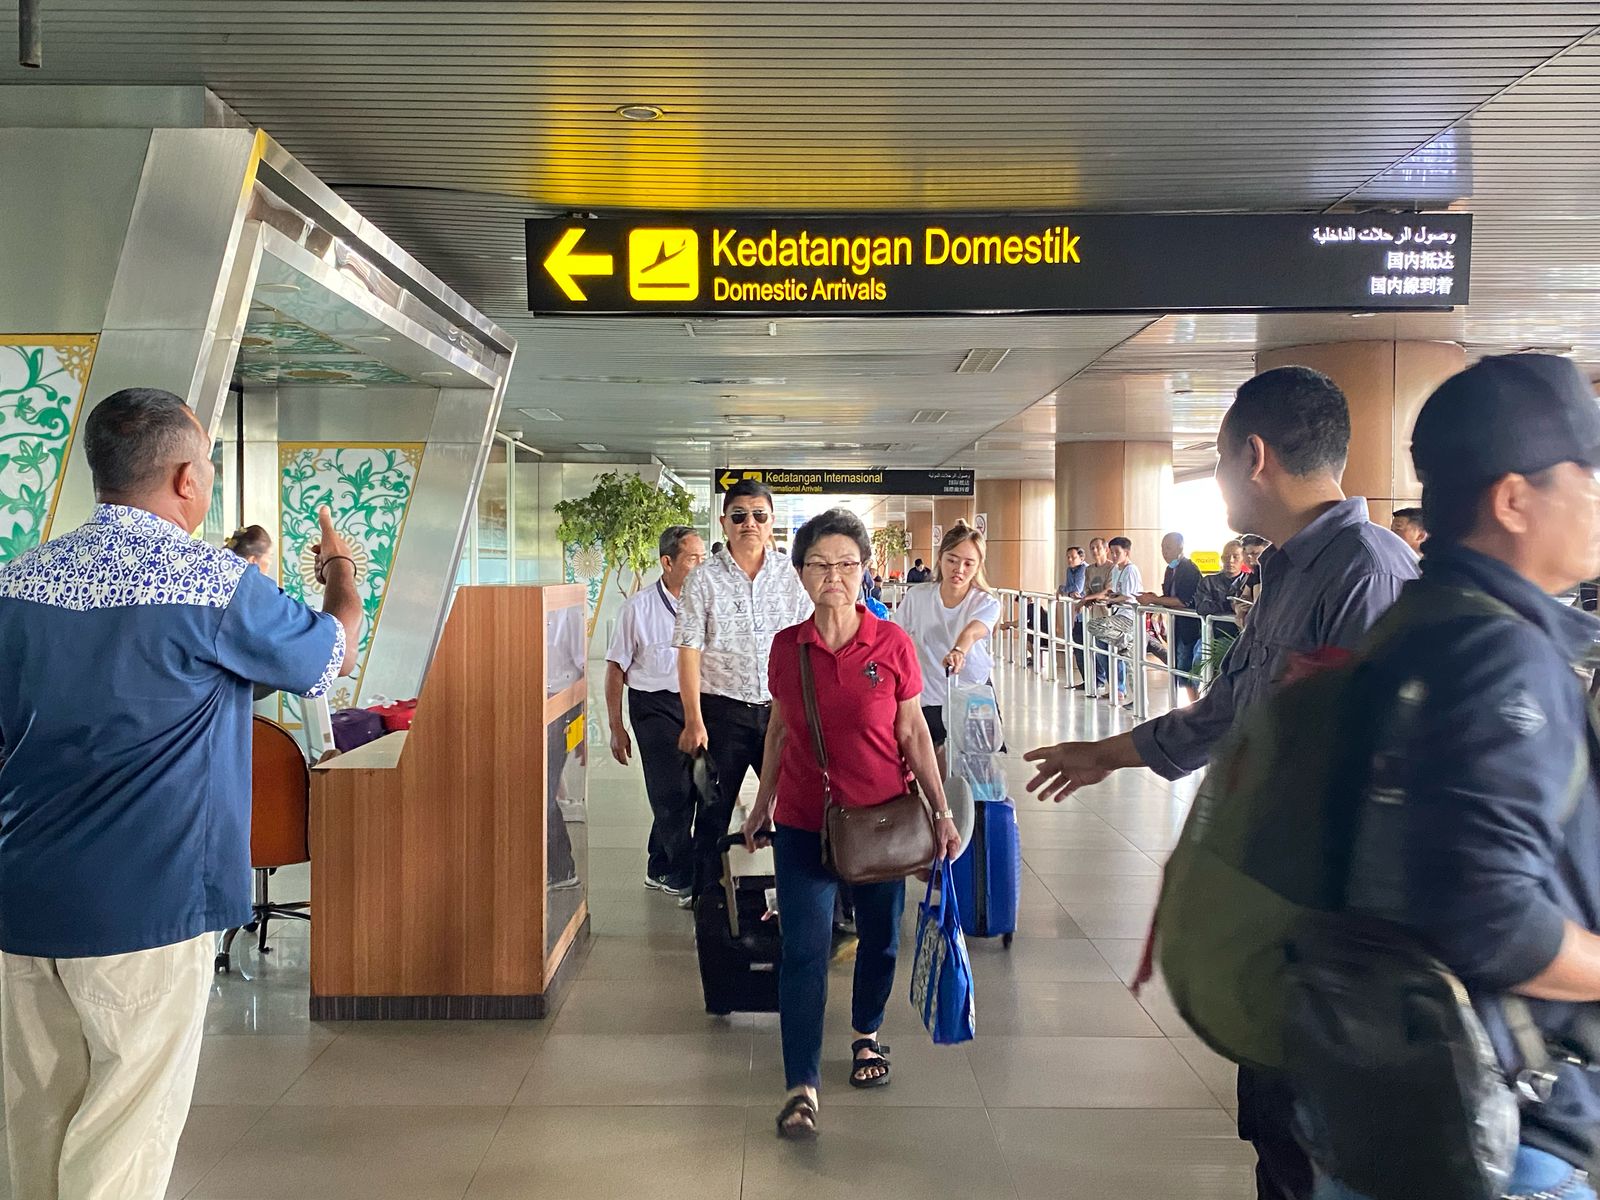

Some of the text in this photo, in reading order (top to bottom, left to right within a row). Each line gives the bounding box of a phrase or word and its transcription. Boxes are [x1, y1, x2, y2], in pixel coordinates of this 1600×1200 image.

[1312, 227, 1355, 244] الداخلية
[1414, 226, 1456, 244] وصول
[713, 227, 1080, 275] Kedatangan Domestik
[1387, 251, 1455, 270] 国内抵达
[714, 277, 886, 301] Domestic Arrivals
[766, 472, 883, 484] Kedatangan Internasional
[801, 485, 823, 493] Arrivals
